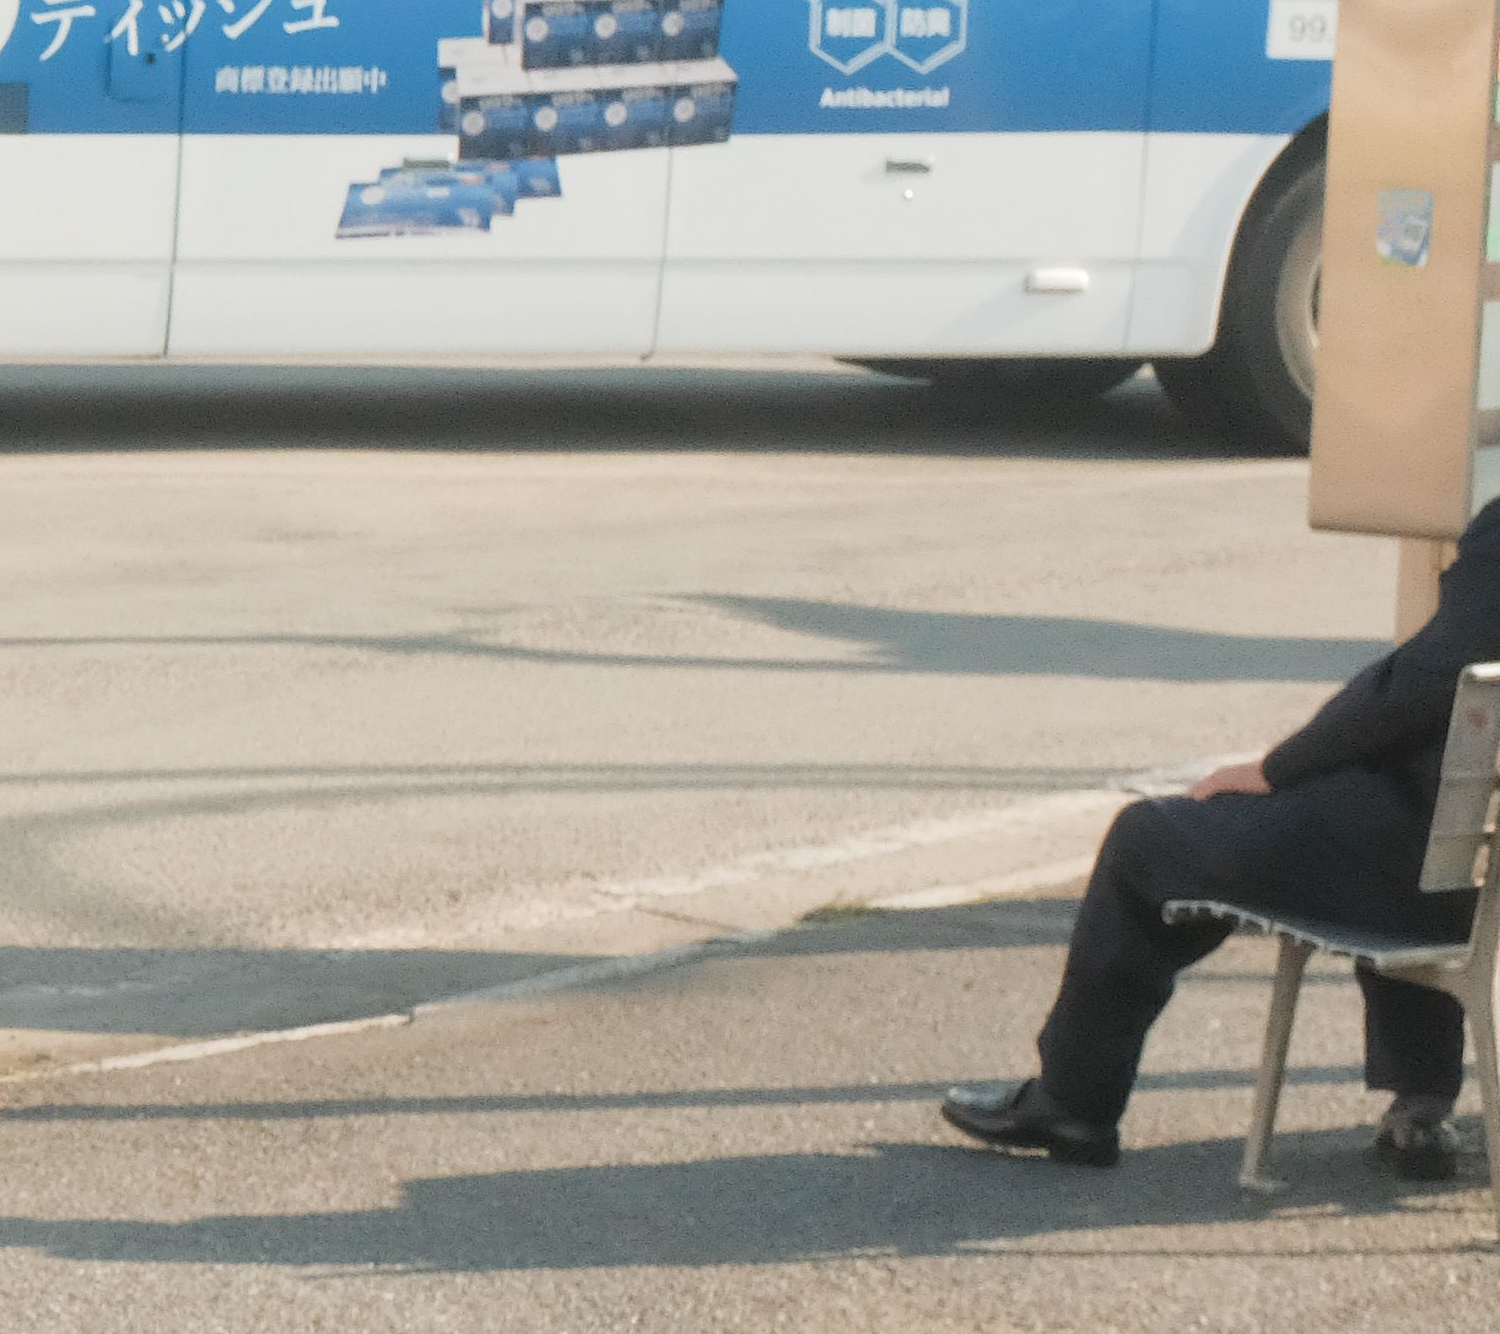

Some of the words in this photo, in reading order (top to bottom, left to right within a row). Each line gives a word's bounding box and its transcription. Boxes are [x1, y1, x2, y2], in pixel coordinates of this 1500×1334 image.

[215, 65, 388, 95] 商標登録出願中
[819, 85, 950, 109] Antibacterial
